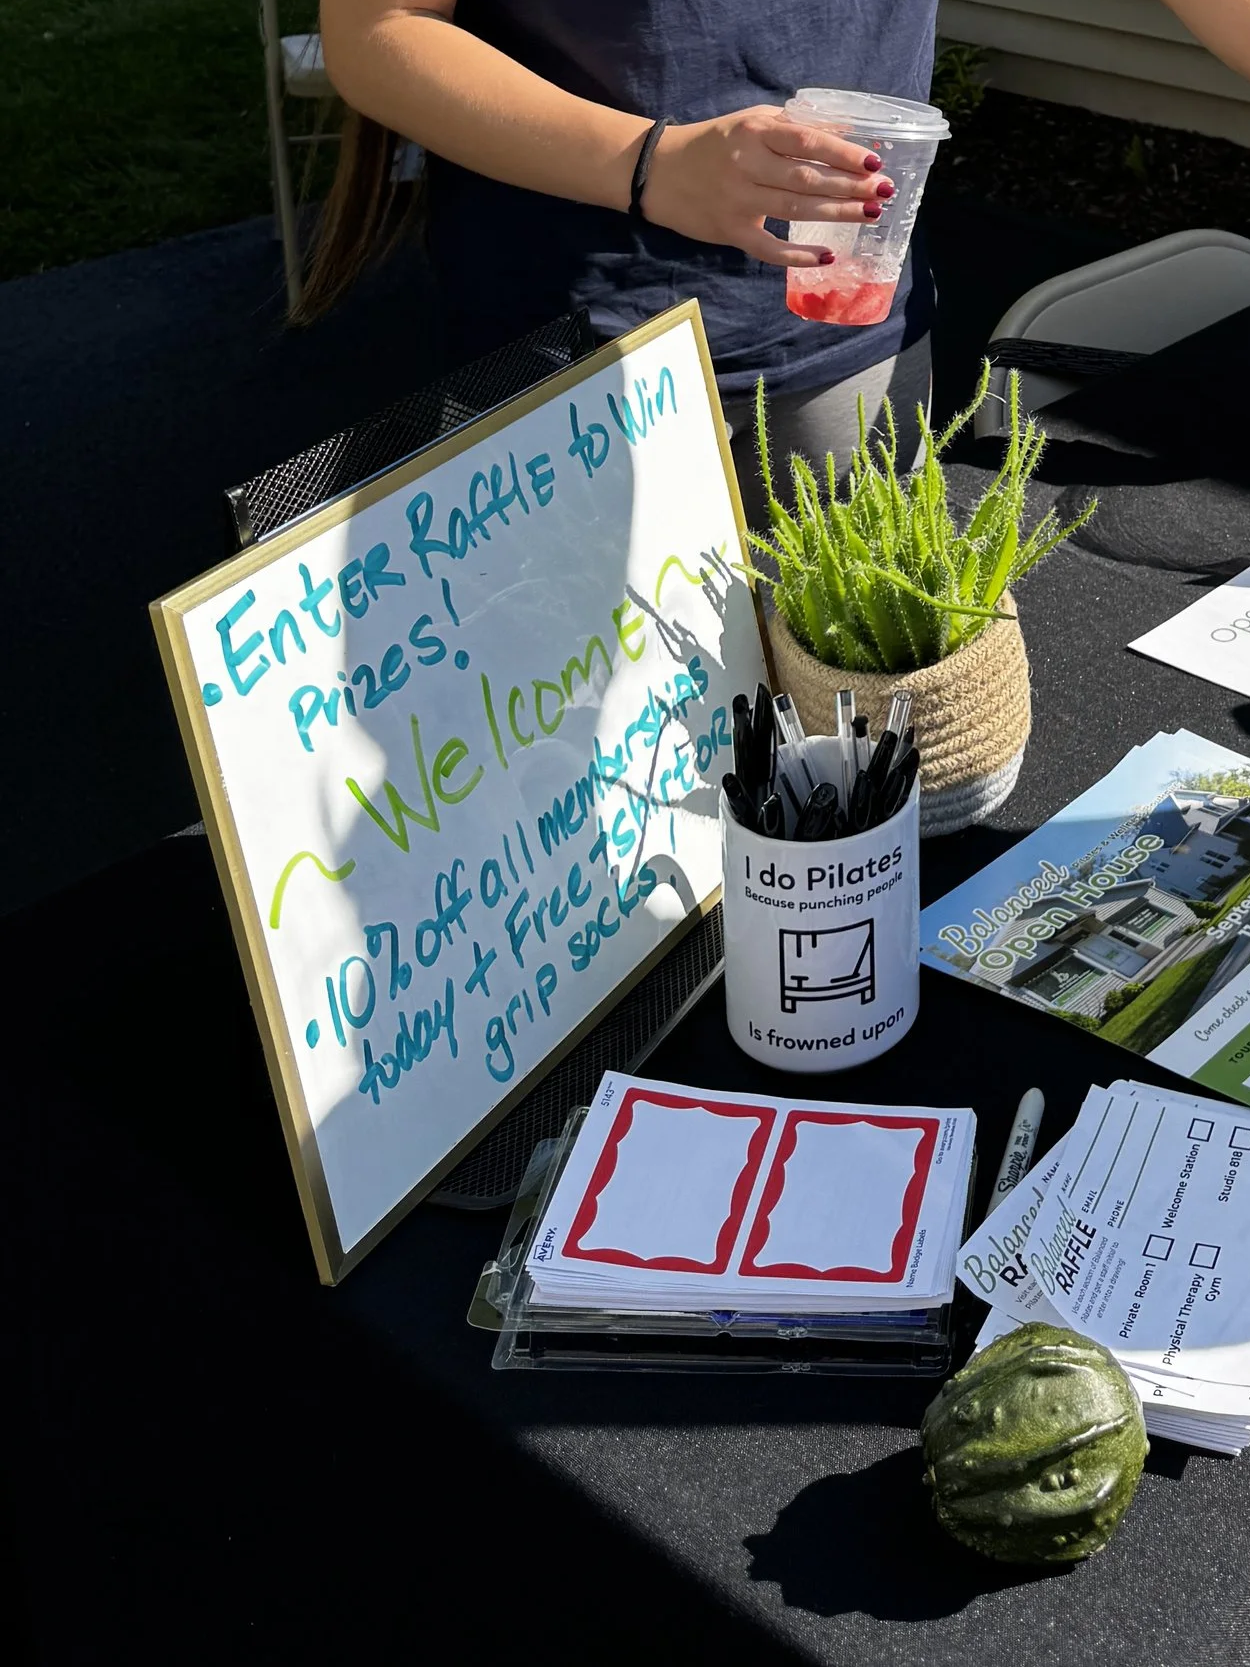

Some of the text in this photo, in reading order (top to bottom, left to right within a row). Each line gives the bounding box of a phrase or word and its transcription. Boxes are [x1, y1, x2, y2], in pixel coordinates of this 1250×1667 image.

[569, 402, 609, 478] to
[745, 846, 902, 891] I do Pilates
[745, 871, 903, 912] Because punching people
[977, 834, 1164, 971] Open House
[325, 921, 412, 1047] 10%
[415, 858, 473, 967] off
[480, 821, 536, 908] all
[939, 860, 1070, 957] Balanced
[358, 978, 459, 1104] today
[505, 863, 592, 968] Free
[1194, 1017, 1224, 1041] Come
[1222, 995, 1248, 1018] check
[486, 963, 558, 1082] grip
[749, 1007, 904, 1050] Is frowned upon
[601, 1088, 614, 1107] 5143
[537, 1227, 556, 1263] AVERY
[1031, 1195, 1077, 1296] Balanced
[1055, 1190, 1097, 1296] RAFFLE EMAIL
[1106, 1199, 1124, 1227] PHONE
[1118, 1302, 1140, 1338] Private
[1134, 1269, 1153, 1298] Room
[1161, 1180, 1187, 1228] Welcome
[1179, 1143, 1200, 1179] Station
[906, 1229, 927, 1287] Name Badge Labels
[1162, 1150, 1243, 1365] Physical Therapy Studio 818
[1204, 1277, 1221, 1301] Gym
